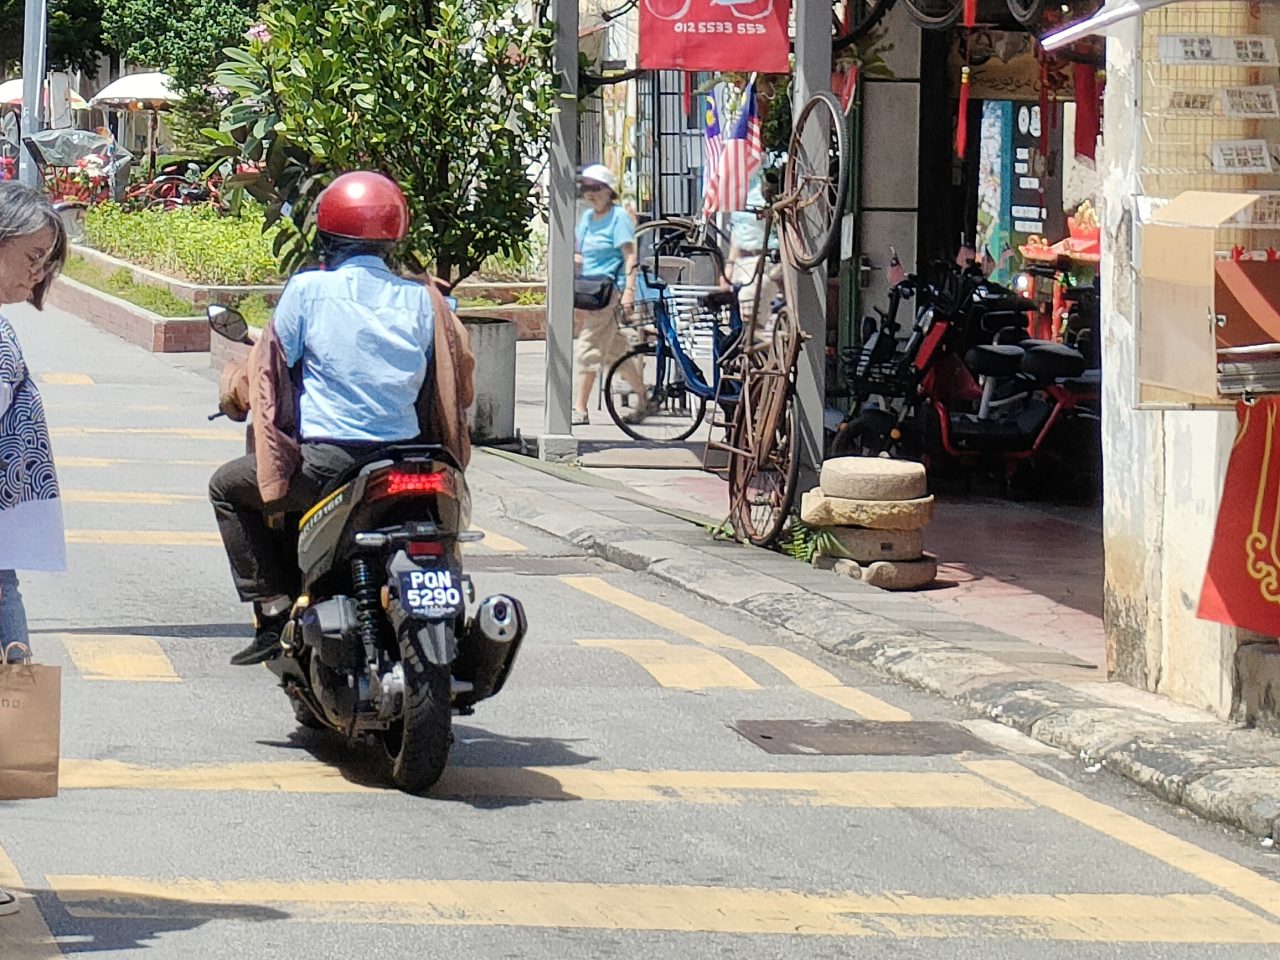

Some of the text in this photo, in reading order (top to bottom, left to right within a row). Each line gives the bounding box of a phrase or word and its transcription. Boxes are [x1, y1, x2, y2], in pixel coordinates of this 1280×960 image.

[674, 22, 696, 33] 012
[409, 570, 452, 589] PQN
[407, 587, 460, 607] 5290
